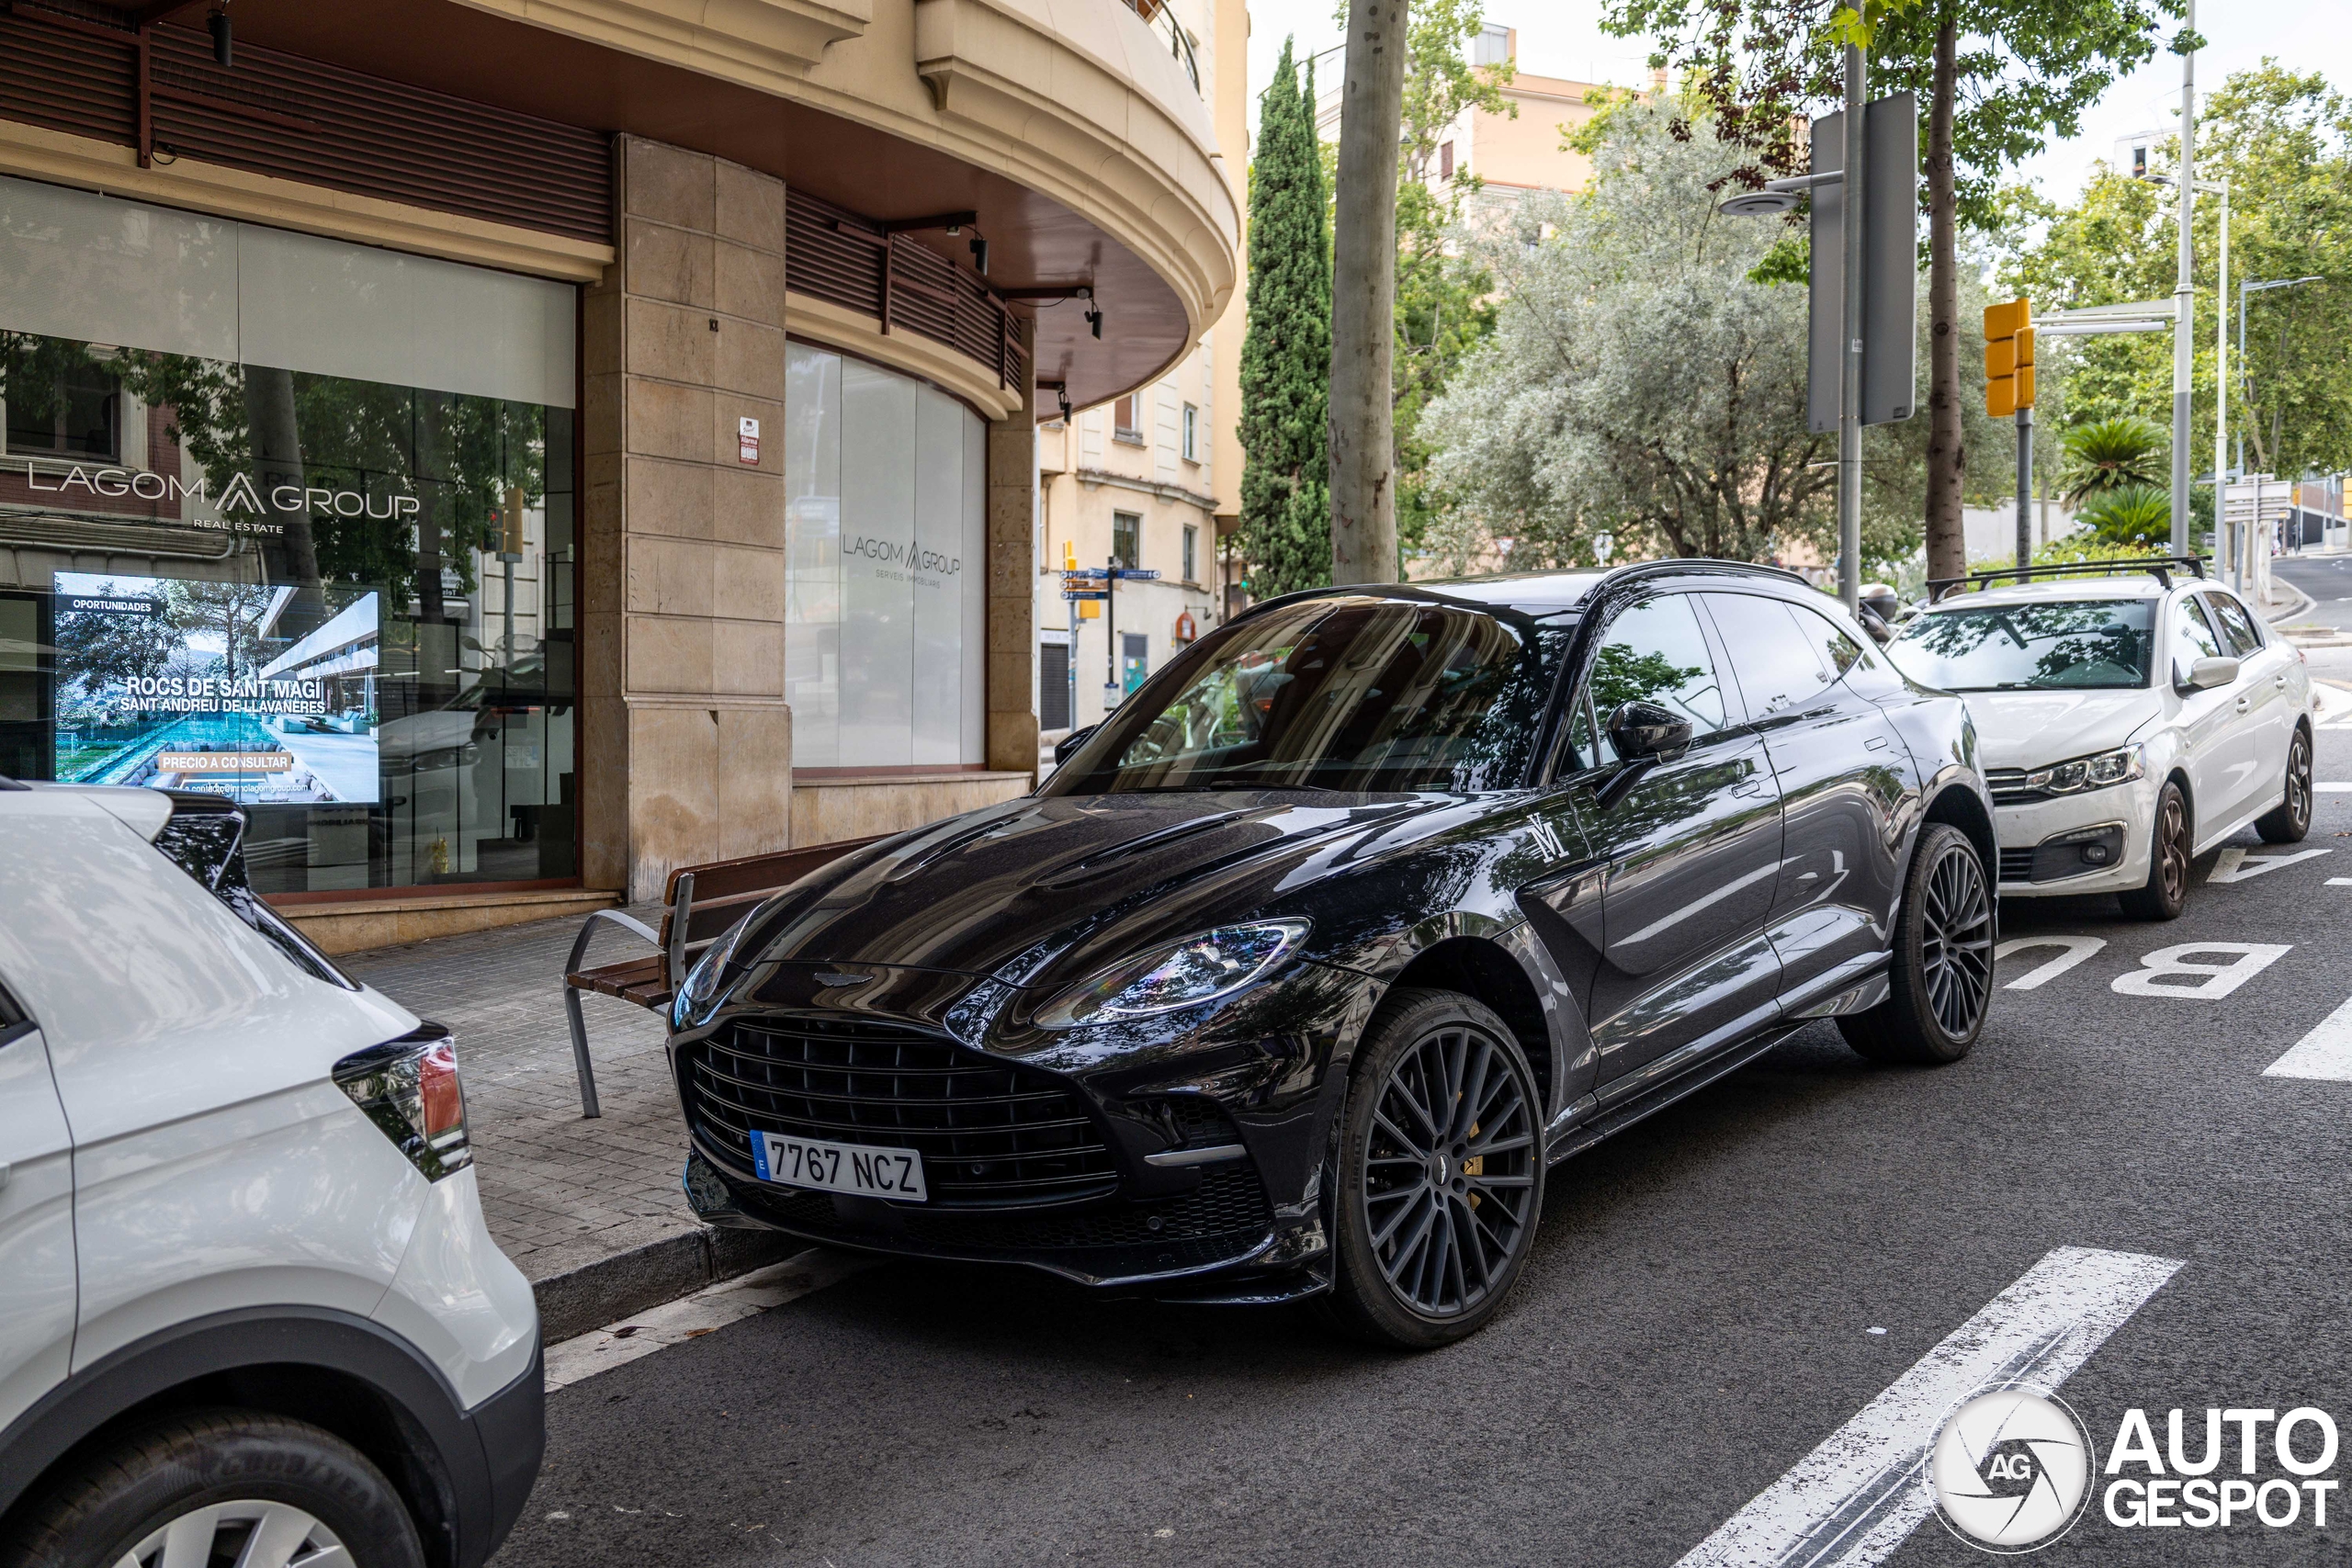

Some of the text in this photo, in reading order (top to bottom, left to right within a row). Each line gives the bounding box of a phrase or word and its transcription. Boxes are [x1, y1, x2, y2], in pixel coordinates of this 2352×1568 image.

[28, 461, 421, 521] LAGOM GROUP
[193, 519, 284, 534] REAL ESTATE
[842, 534, 961, 576] LAGOM GROUP
[876, 569, 941, 590] SERVEIS IMMOBILIARIS
[73, 599, 153, 613] OPORTUNIDADES
[126, 675, 322, 700] ROCS DE SANT MAGÍ
[119, 697, 326, 714] SANT ANDREU DE LLAVANERES
[163, 756, 288, 769] PRECIO A CONSULTAR
[759, 1159, 765, 1170] E
[770, 1140, 918, 1193] 7767 NCZ
[1348, 1134, 1363, 1190] PIRELLI
